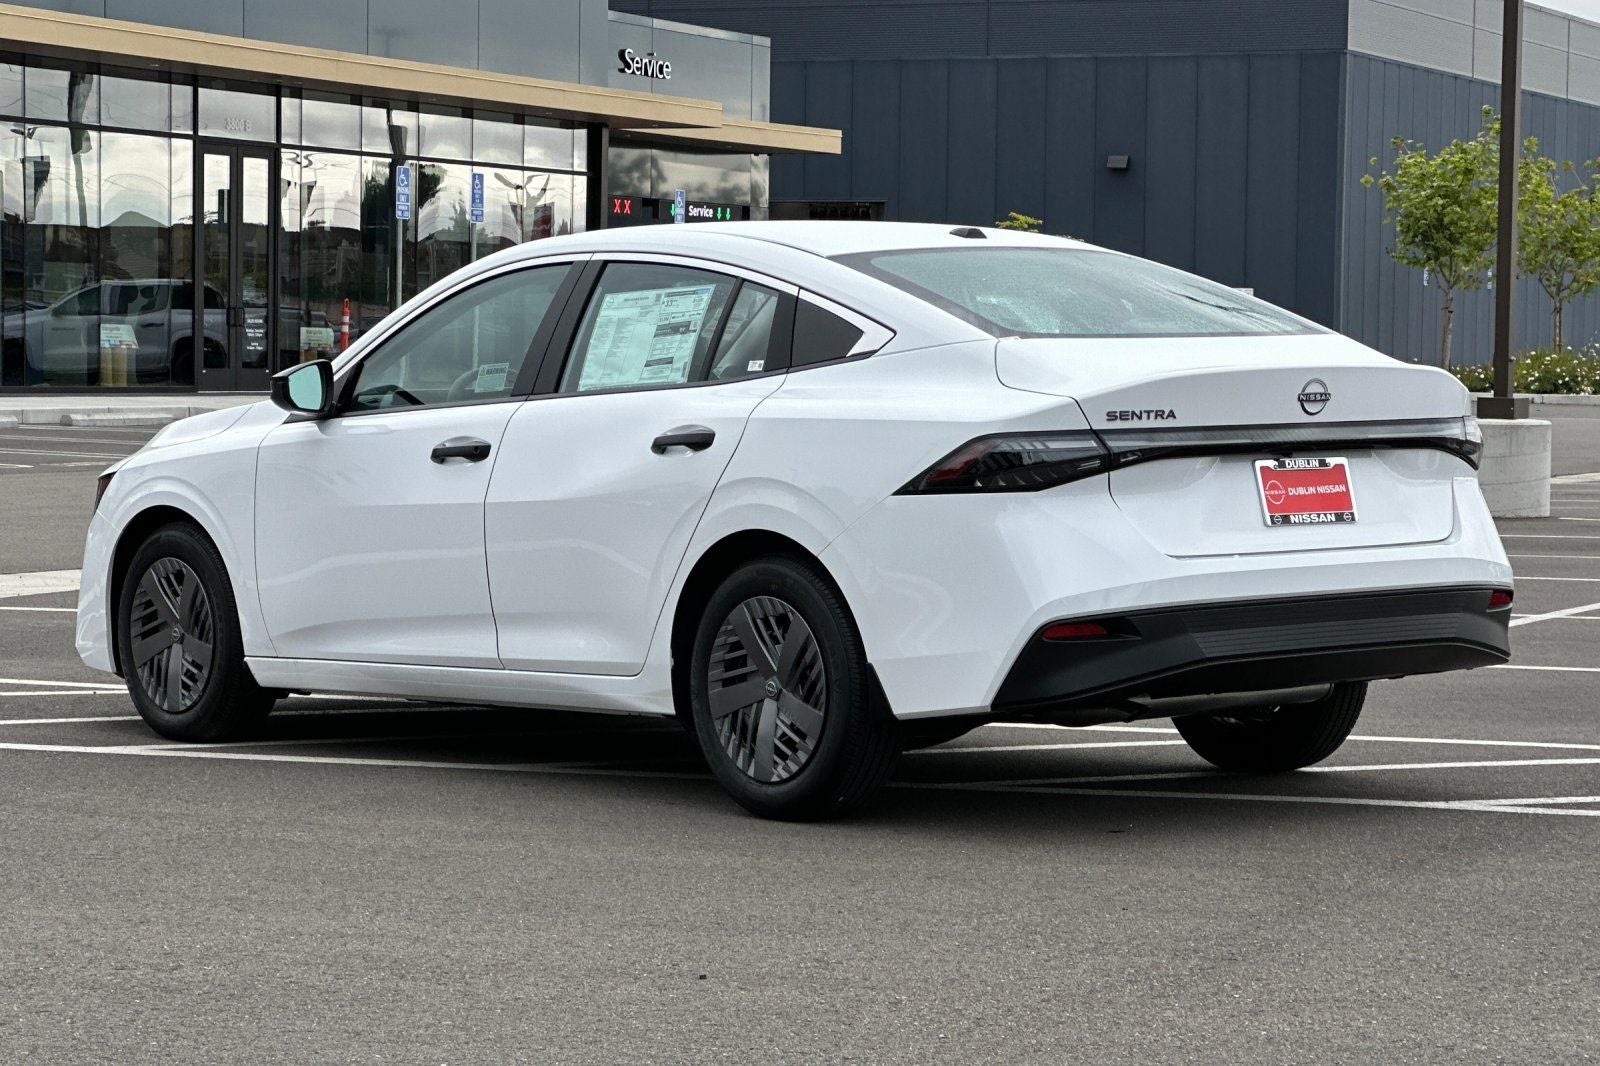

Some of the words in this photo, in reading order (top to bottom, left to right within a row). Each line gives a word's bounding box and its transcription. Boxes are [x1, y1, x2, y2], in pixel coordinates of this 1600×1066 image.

[623, 48, 672, 79] Service
[688, 205, 714, 218] Service
[1298, 392, 1332, 401] NISSAN
[1105, 409, 1177, 421] SENTRA
[1285, 458, 1319, 468] DUBLIN
[1287, 485, 1317, 495] DUBLIN
[1317, 484, 1347, 494] NISSAN
[1290, 513, 1336, 523] NISSAN
